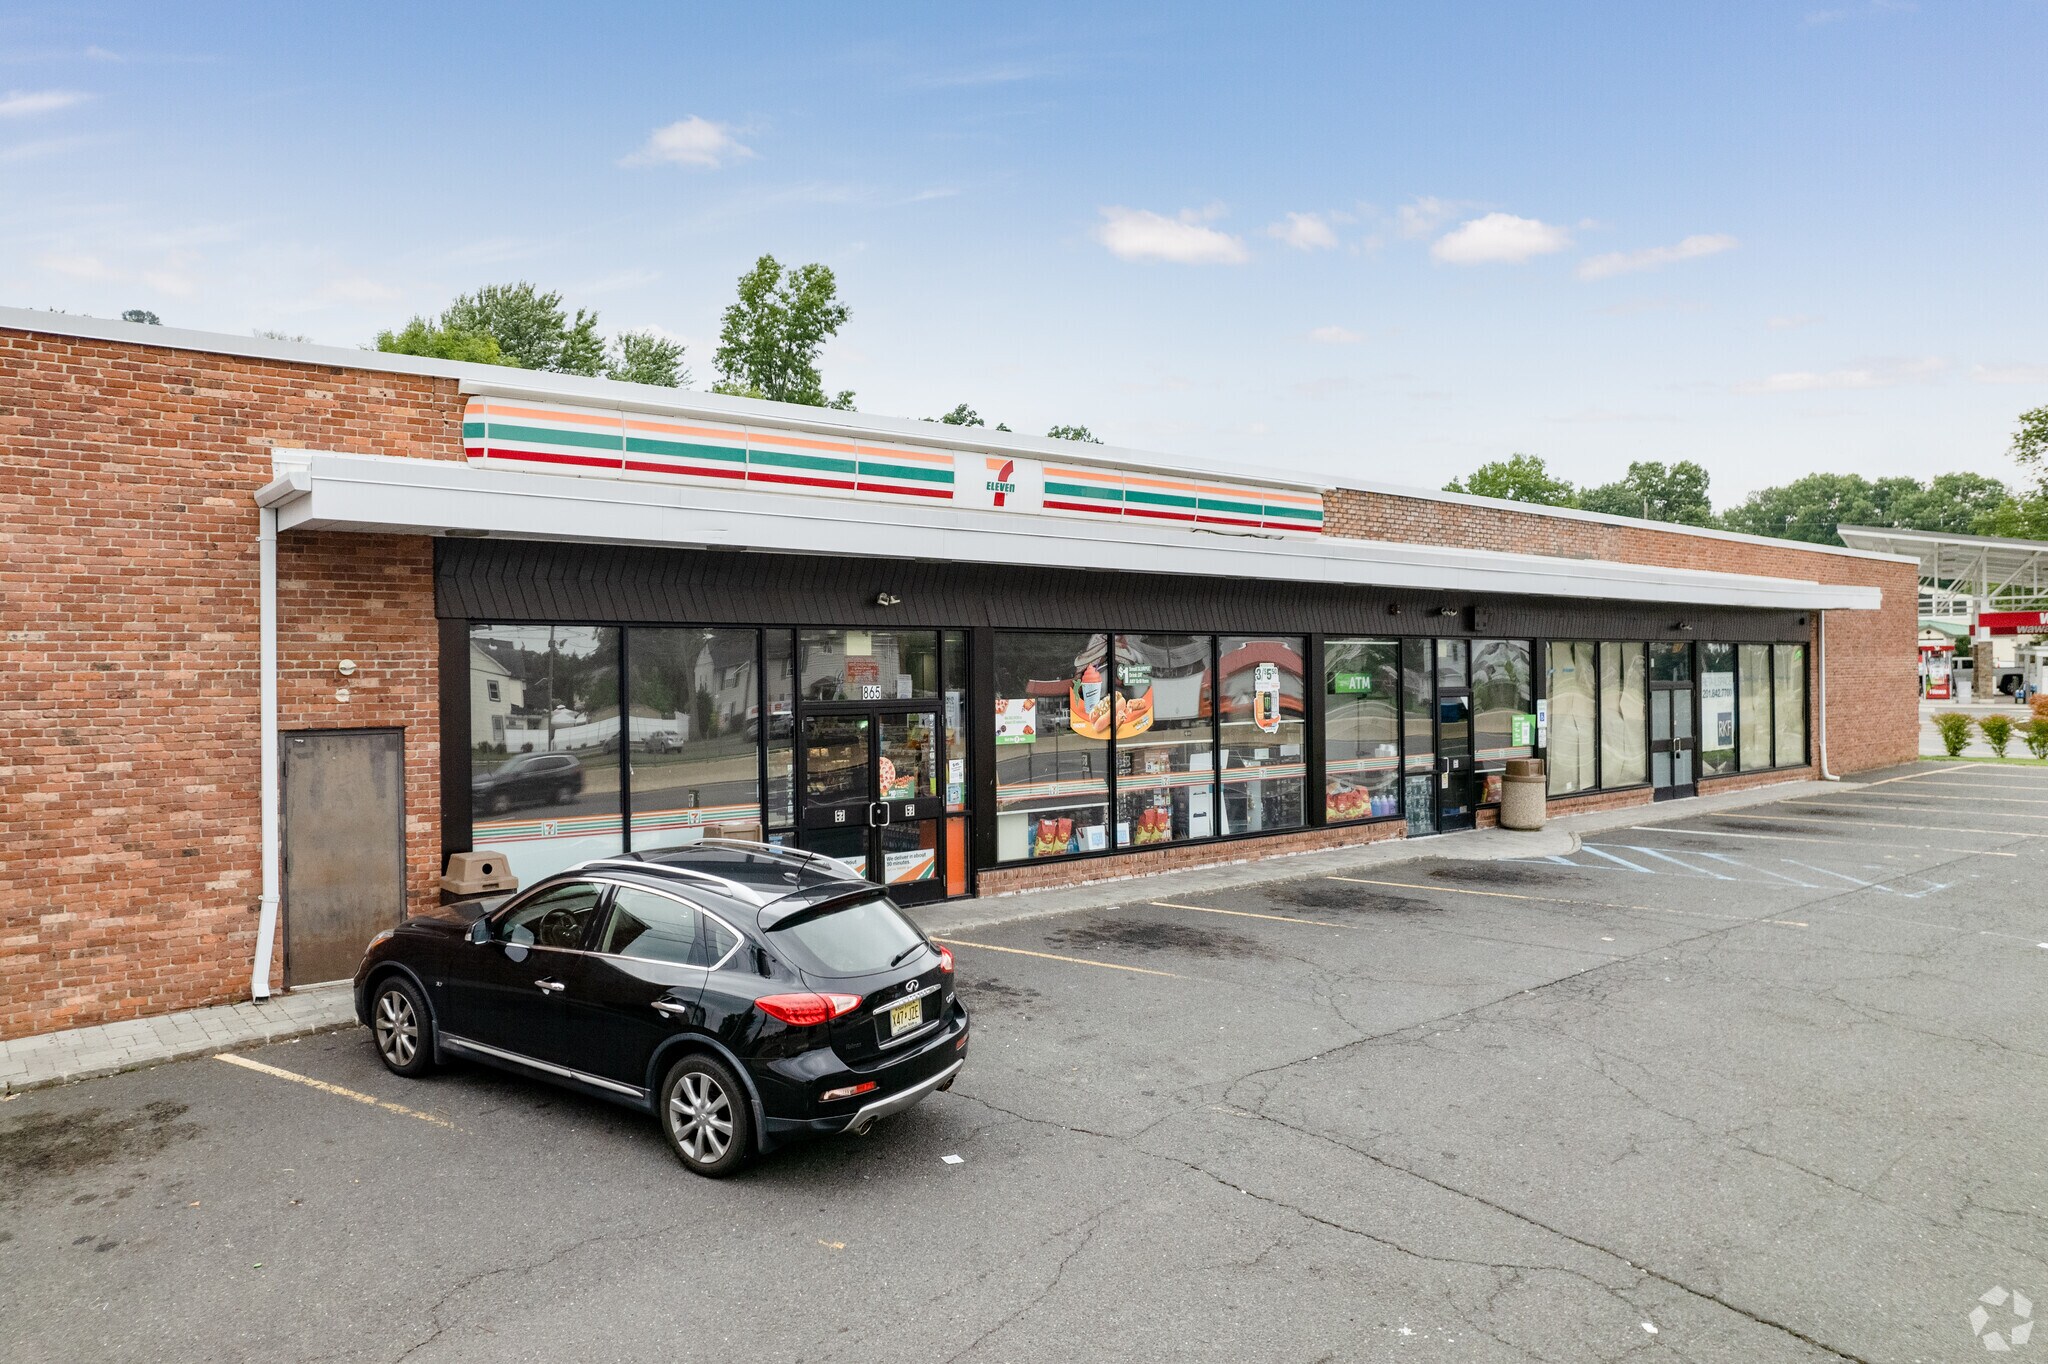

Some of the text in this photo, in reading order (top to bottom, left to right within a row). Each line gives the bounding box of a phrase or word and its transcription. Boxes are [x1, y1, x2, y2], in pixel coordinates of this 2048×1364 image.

[986, 458, 1014, 507] 7
[1118, 666, 1129, 684] $1
[1349, 676, 1371, 690] ATM
[863, 686, 881, 699] 865
